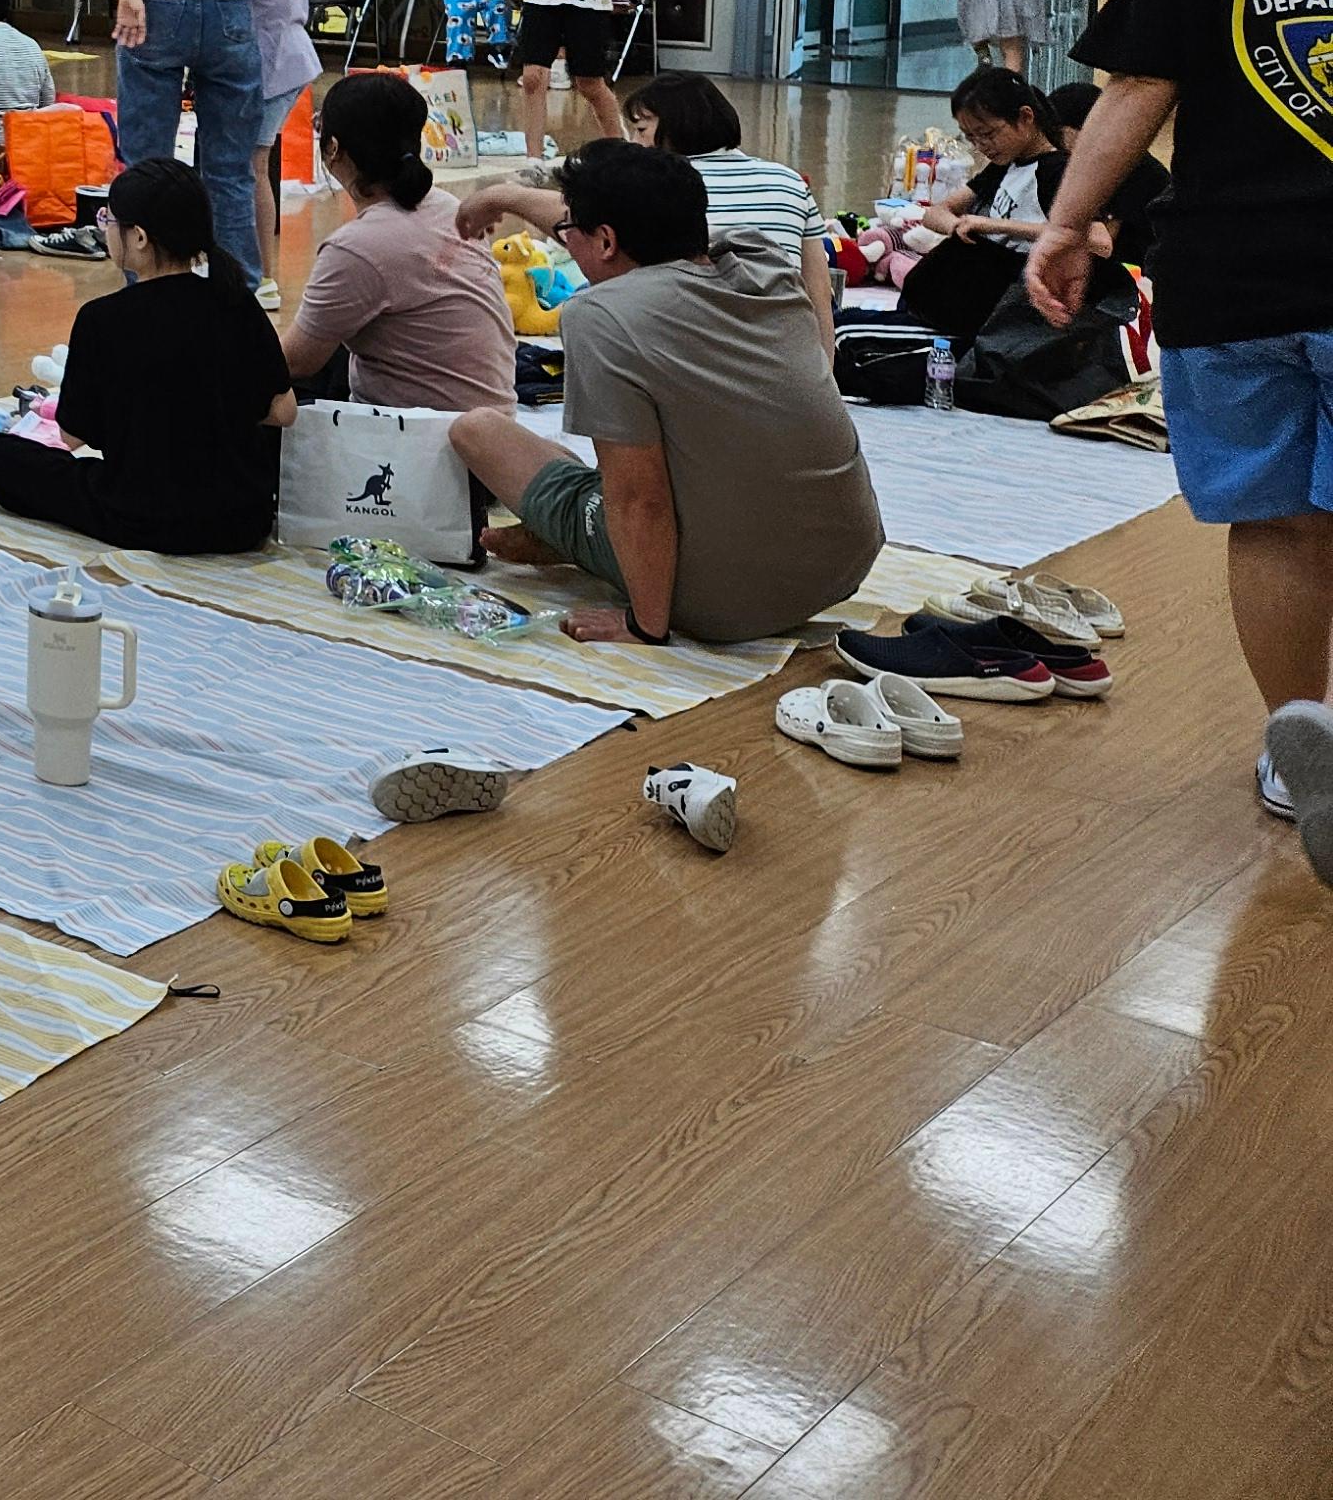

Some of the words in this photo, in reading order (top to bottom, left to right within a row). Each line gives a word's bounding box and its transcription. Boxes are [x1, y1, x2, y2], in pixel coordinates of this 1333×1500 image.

[1254, 45, 1294, 90] CITY
[1288, 92, 1323, 119] OF
[345, 504, 397, 518] KANGOL
